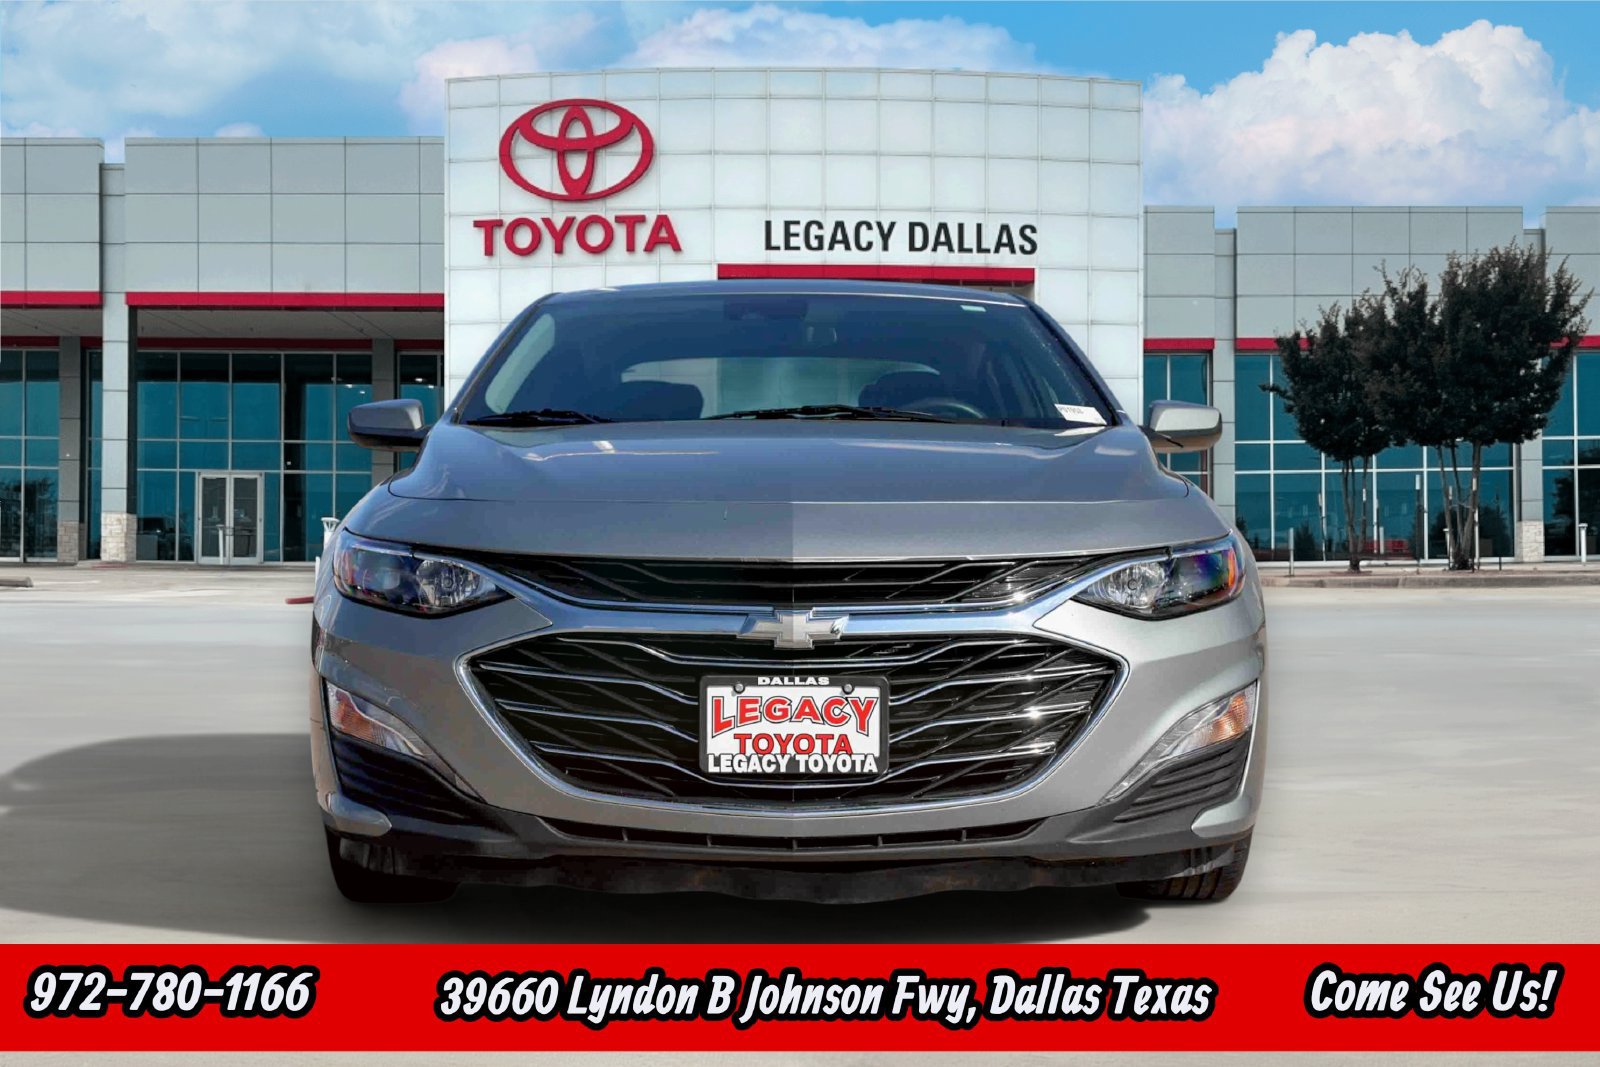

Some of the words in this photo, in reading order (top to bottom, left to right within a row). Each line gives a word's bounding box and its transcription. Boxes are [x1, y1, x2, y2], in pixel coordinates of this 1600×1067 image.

[473, 214, 682, 256] TOYOTA
[764, 220, 897, 252] LEGACY
[908, 221, 1038, 256] DALLAS
[757, 676, 830, 686] DALLAS
[711, 695, 879, 739] LEGACY
[733, 732, 854, 756] TOYOTA
[707, 753, 790, 773] LEGACY
[794, 753, 879, 773] TOYOTA
